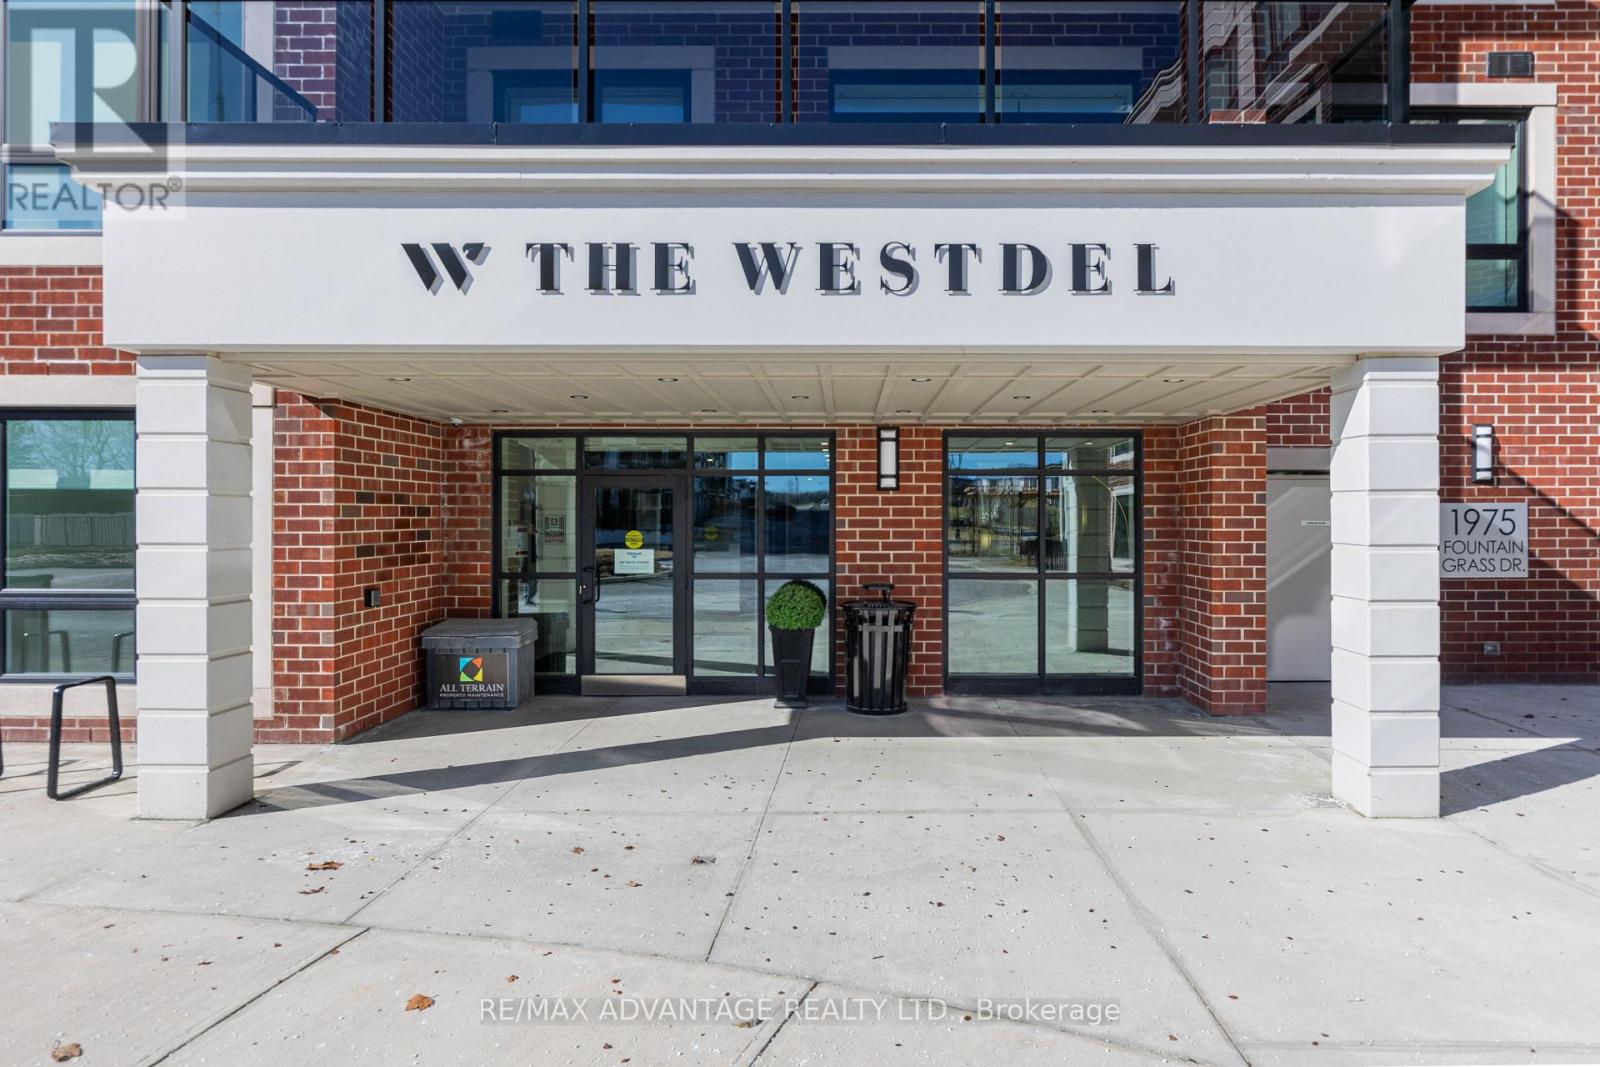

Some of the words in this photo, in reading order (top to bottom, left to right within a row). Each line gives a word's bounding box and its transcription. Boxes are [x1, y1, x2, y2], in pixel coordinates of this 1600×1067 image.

[525, 241, 696, 296] THE
[731, 241, 1176, 297] WESTDEL
[1450, 508, 1516, 536] 1975
[1443, 540, 1524, 555] FOUNTAIN
[1441, 557, 1496, 573] GRASS
[440, 684, 458, 692] ALL
[459, 684, 504, 692] TERRAIN
